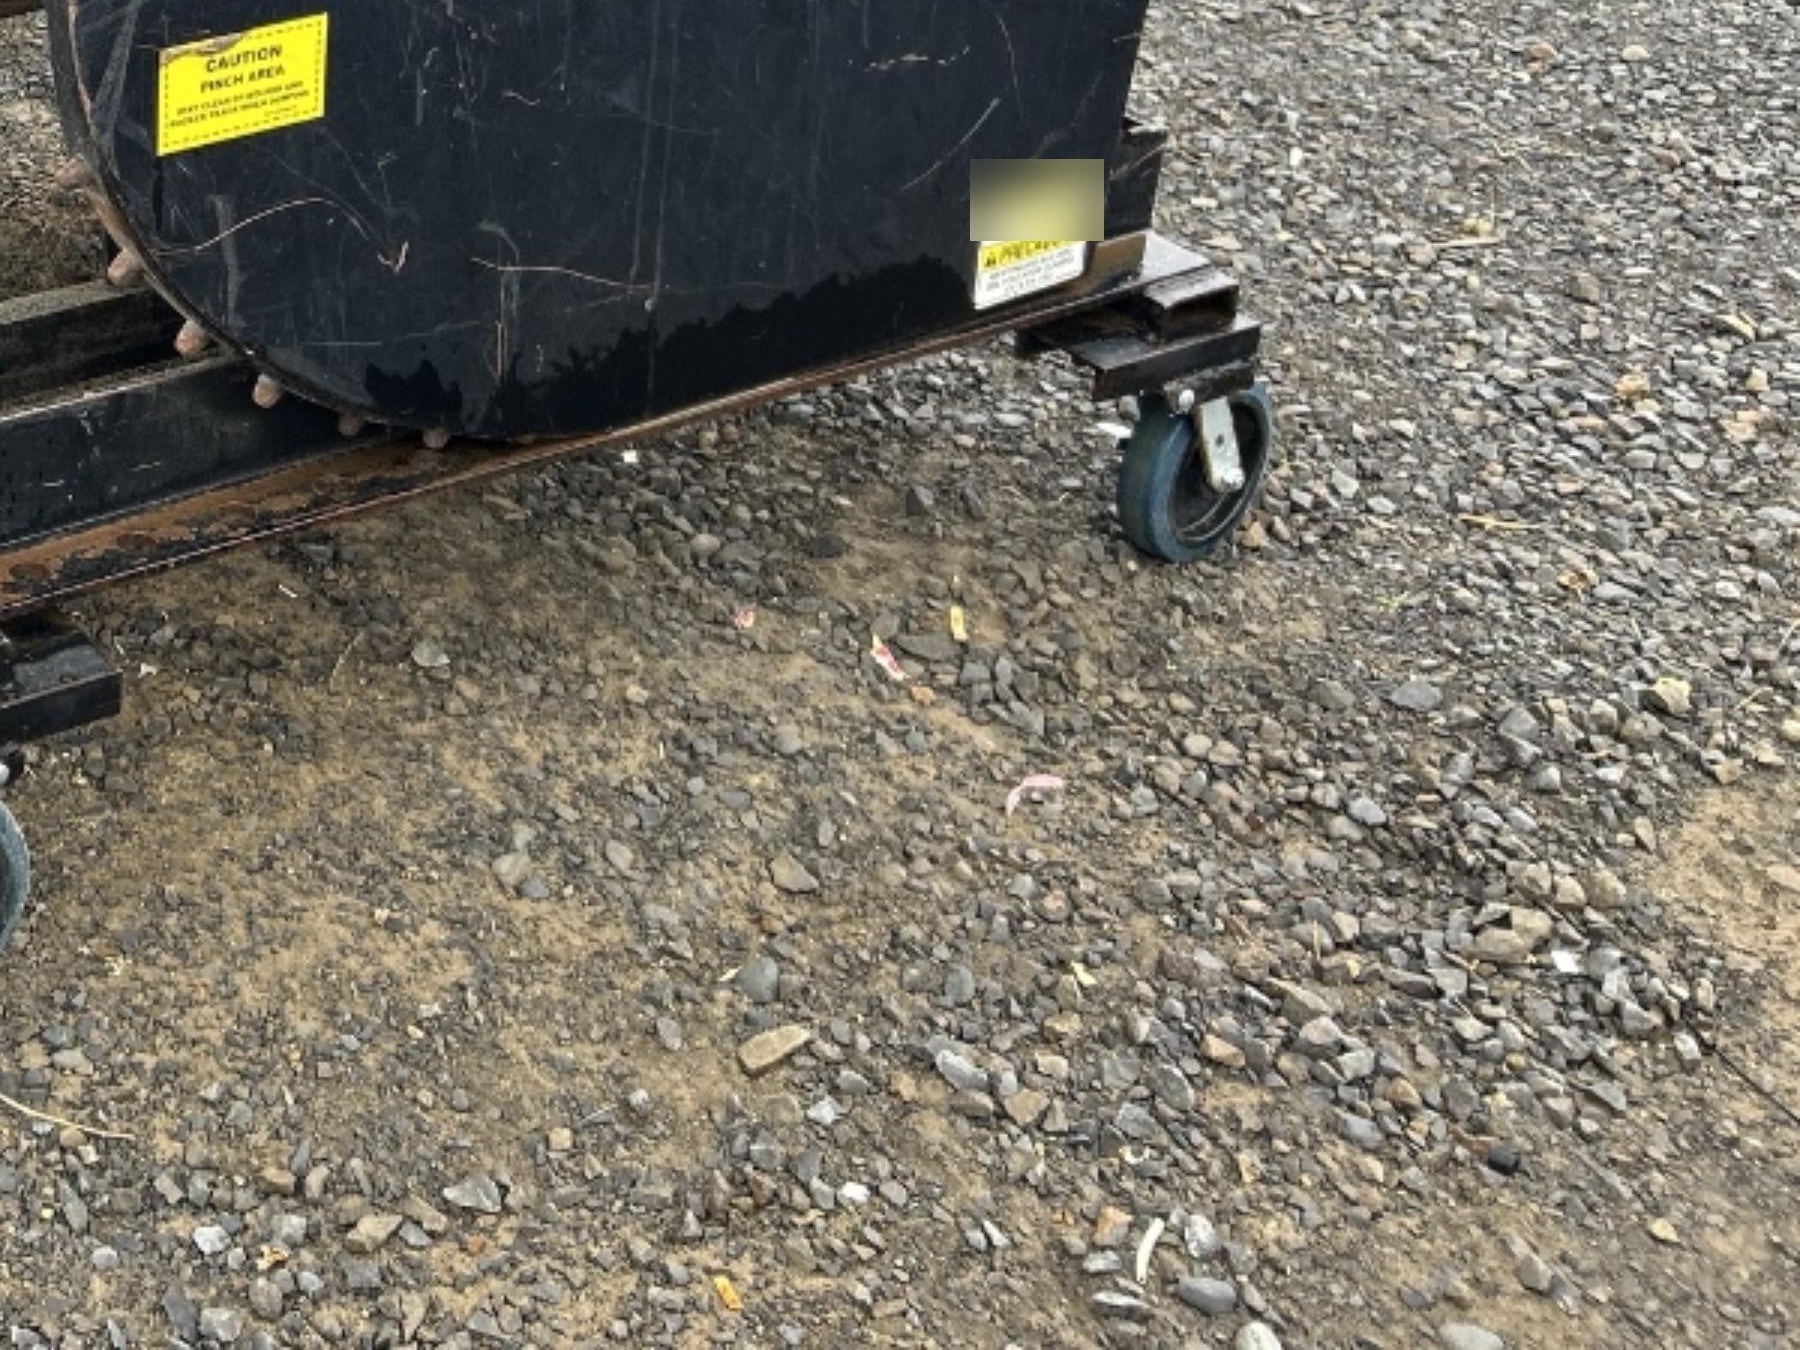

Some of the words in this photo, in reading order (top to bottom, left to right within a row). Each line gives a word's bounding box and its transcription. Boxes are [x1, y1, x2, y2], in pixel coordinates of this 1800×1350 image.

[205, 44, 283, 73] CAUTION
[200, 73, 244, 94] PINCH
[248, 64, 286, 83] AREA
